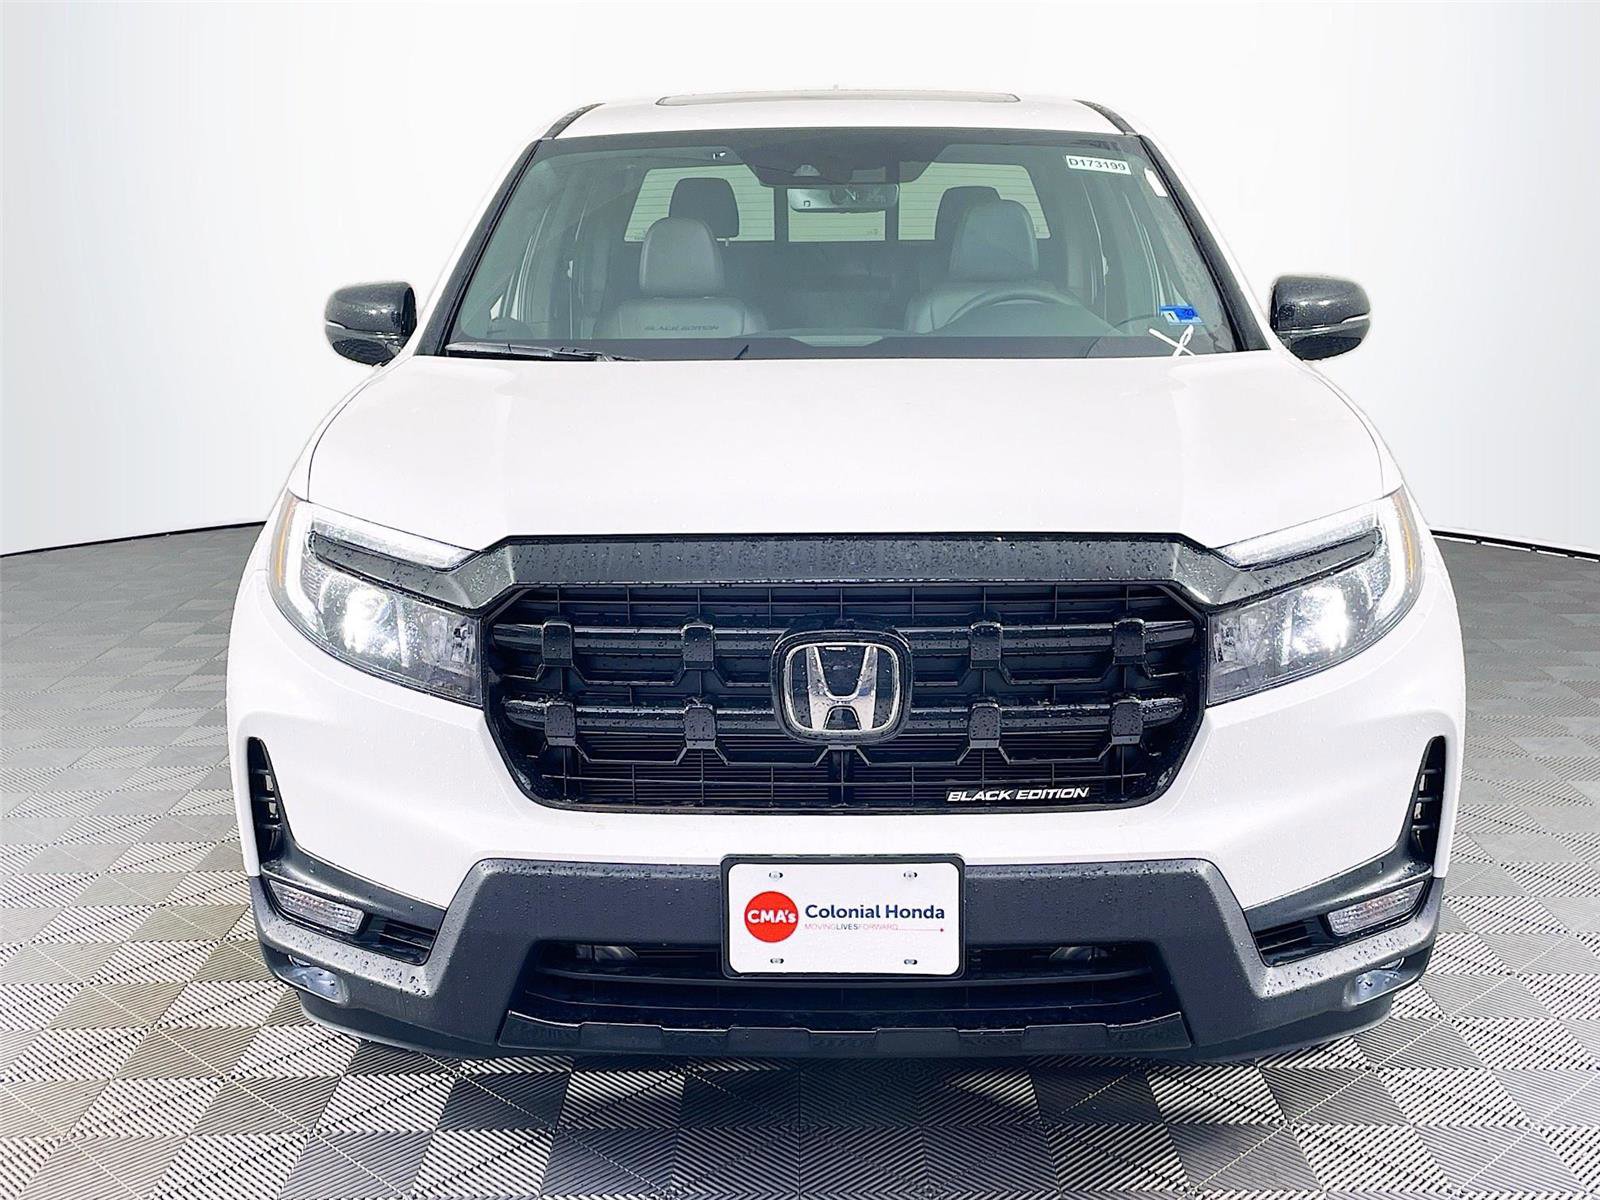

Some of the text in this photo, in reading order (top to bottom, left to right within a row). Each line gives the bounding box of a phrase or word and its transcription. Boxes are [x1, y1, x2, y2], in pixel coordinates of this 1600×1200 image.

[1068, 158, 1126, 170] D173199
[946, 786, 1090, 802] BLACK EDITION
[747, 909, 797, 924] CMA's
[804, 904, 945, 919] Colonial Honda
